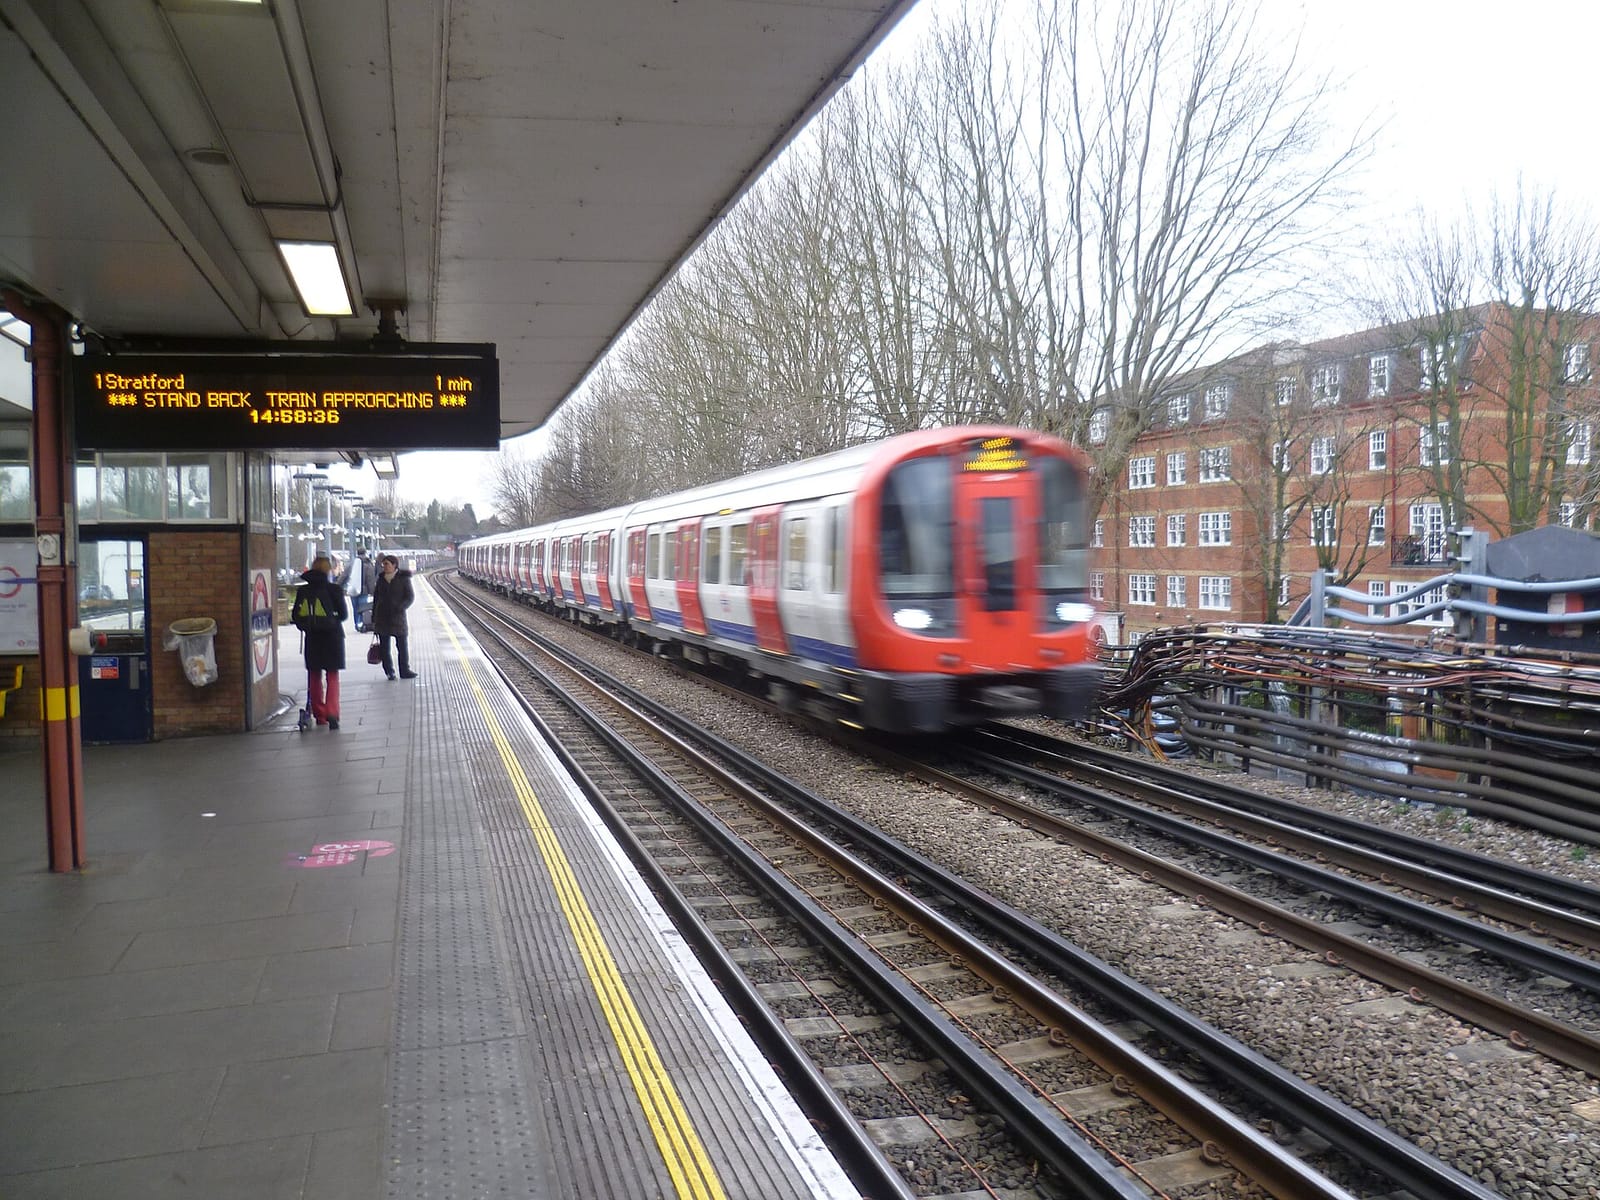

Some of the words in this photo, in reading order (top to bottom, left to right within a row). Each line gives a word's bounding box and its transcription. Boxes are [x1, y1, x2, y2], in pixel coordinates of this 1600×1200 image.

[104, 373, 185, 390] Stratford
[435, 374, 442, 391] 1
[447, 376, 473, 391] min
[143, 392, 202, 408] STAND
[206, 392, 252, 408] BACK
[265, 392, 317, 408] TRAIN
[322, 392, 434, 408] APPROACHING
[249, 409, 340, 424] 14:58:36
